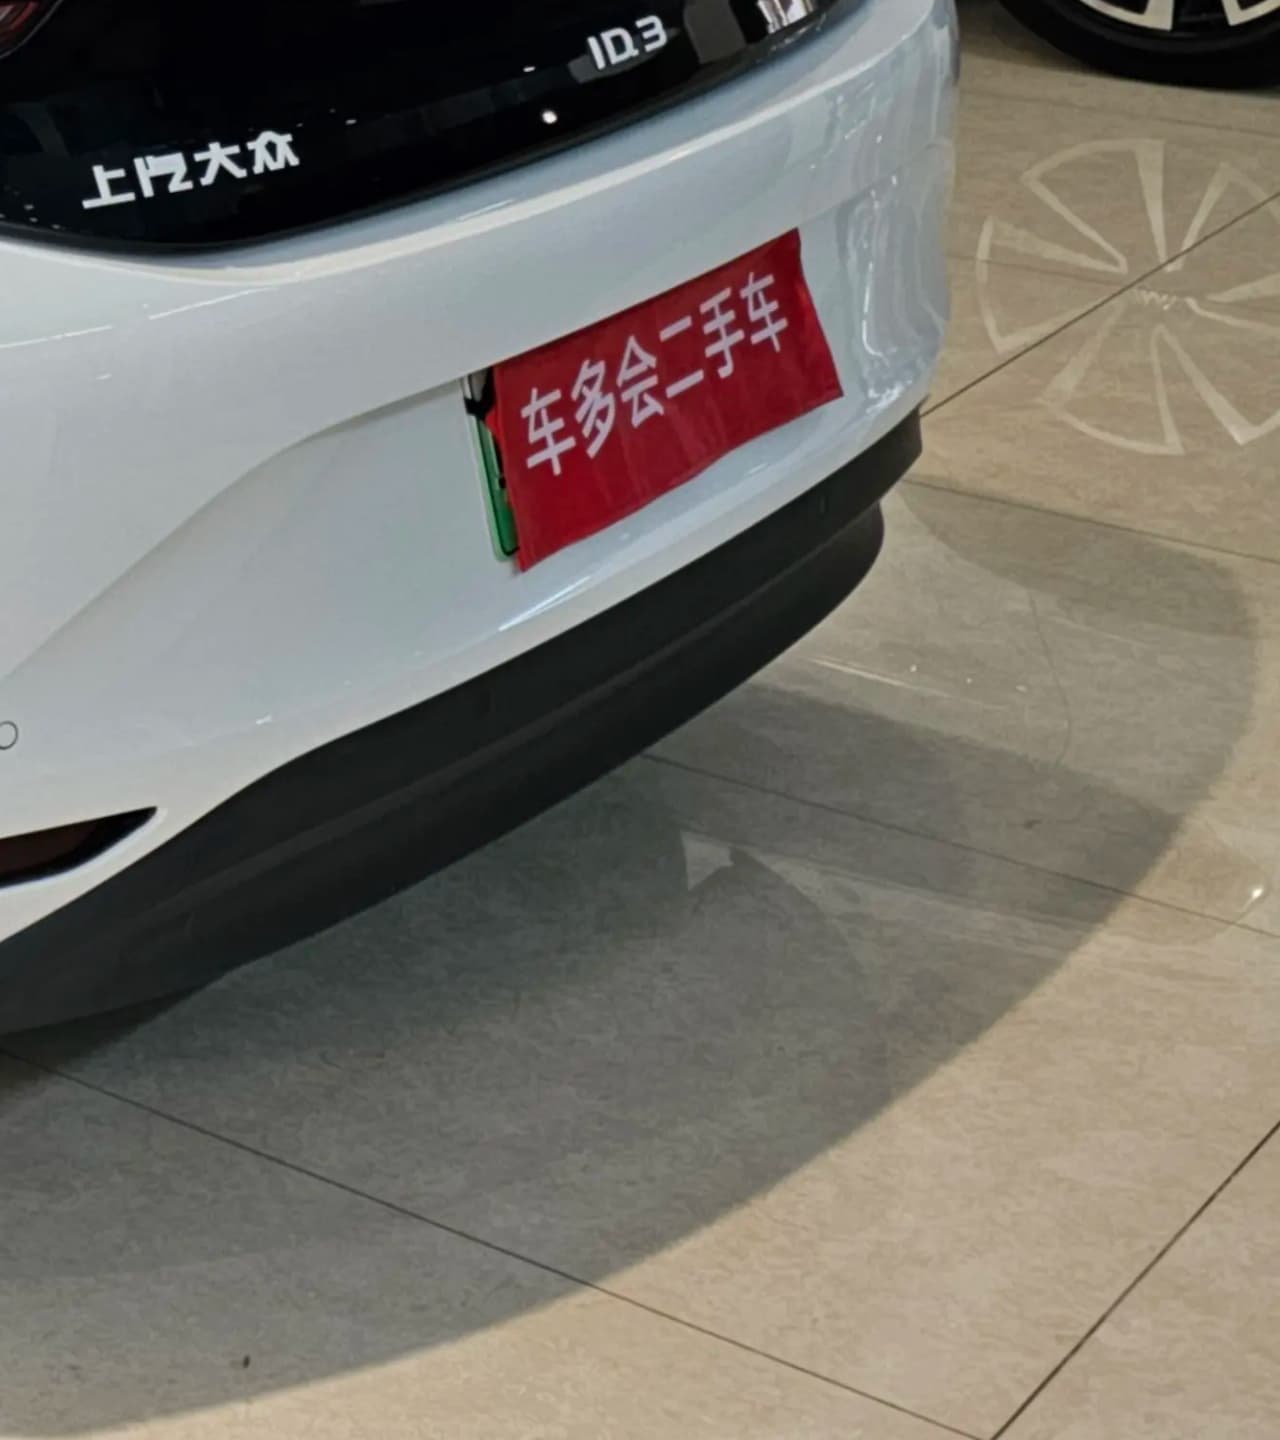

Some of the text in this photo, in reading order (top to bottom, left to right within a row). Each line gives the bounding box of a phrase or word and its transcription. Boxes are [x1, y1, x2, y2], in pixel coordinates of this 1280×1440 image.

[82, 130, 299, 209] 上汽大众
[521, 271, 789, 476] 车多会二手车
